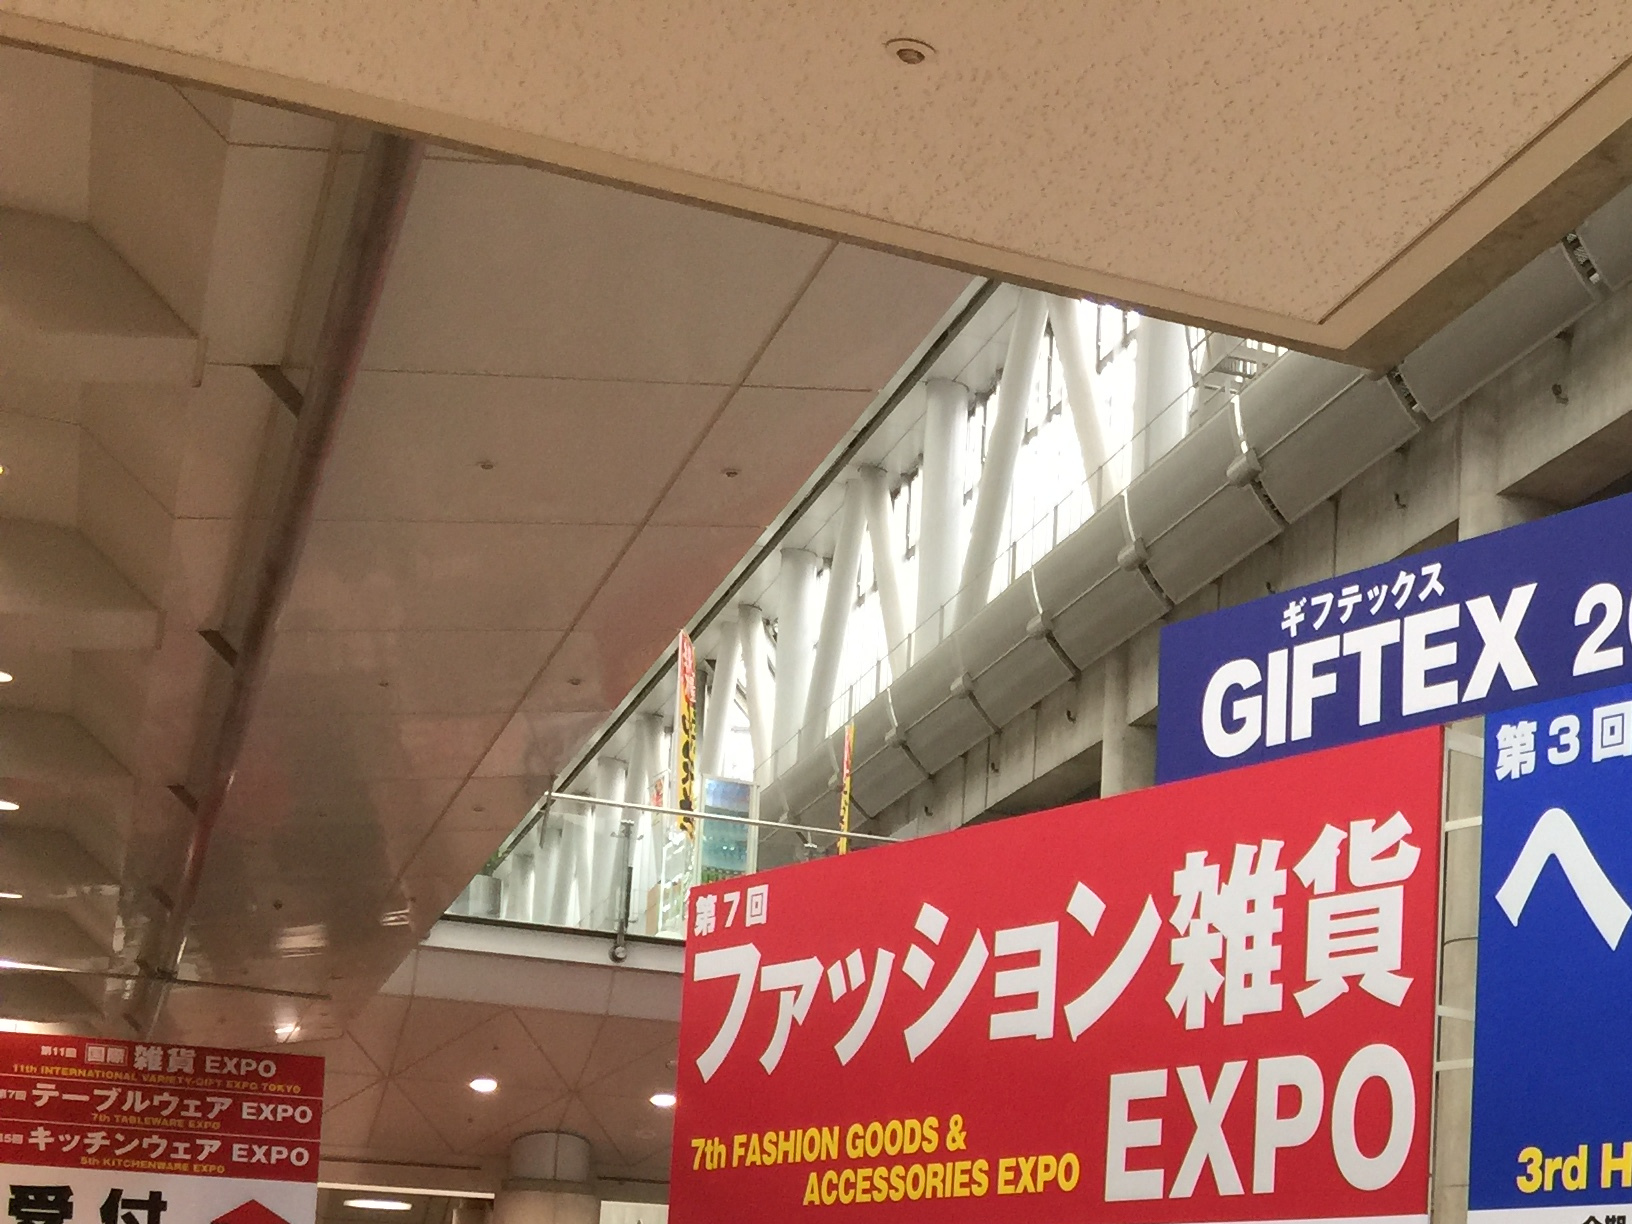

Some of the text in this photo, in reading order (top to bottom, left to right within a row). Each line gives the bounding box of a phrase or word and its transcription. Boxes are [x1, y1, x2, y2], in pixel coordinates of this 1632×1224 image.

[1280, 562, 1445, 637] ギフテックス
[1201, 583, 1538, 758] GIFTEX
[695, 884, 769, 936] 第7回
[693, 810, 1421, 1084] ファッション雑貨
[13, 1064, 38, 1074] 11th
[41, 1065, 138, 1082] INTERNATIONAL
[226, 1080, 258, 1091] EXPO
[262, 1082, 301, 1094] TOKYO
[133, 1044, 196, 1074] 雑貨
[205, 1055, 277, 1078] EXPO
[32, 1083, 233, 1118] テーブルウェア
[241, 1102, 313, 1124] EXPO
[92, 1113, 221, 1130] 7th TABLEWARE EXPO
[1104, 1043, 1416, 1203] EXPO
[28, 1126, 222, 1161] キッチンウェア
[232, 1143, 309, 1167] EXPO
[103, 1159, 190, 1172] KITCHENWARE
[193, 1164, 225, 1174] EXPO
[691, 1113, 968, 1171] 7th FASHION GOODS &
[803, 1152, 1080, 1207] ACCESSORIES EXPO
[1515, 1144, 1587, 1194] 3rd
